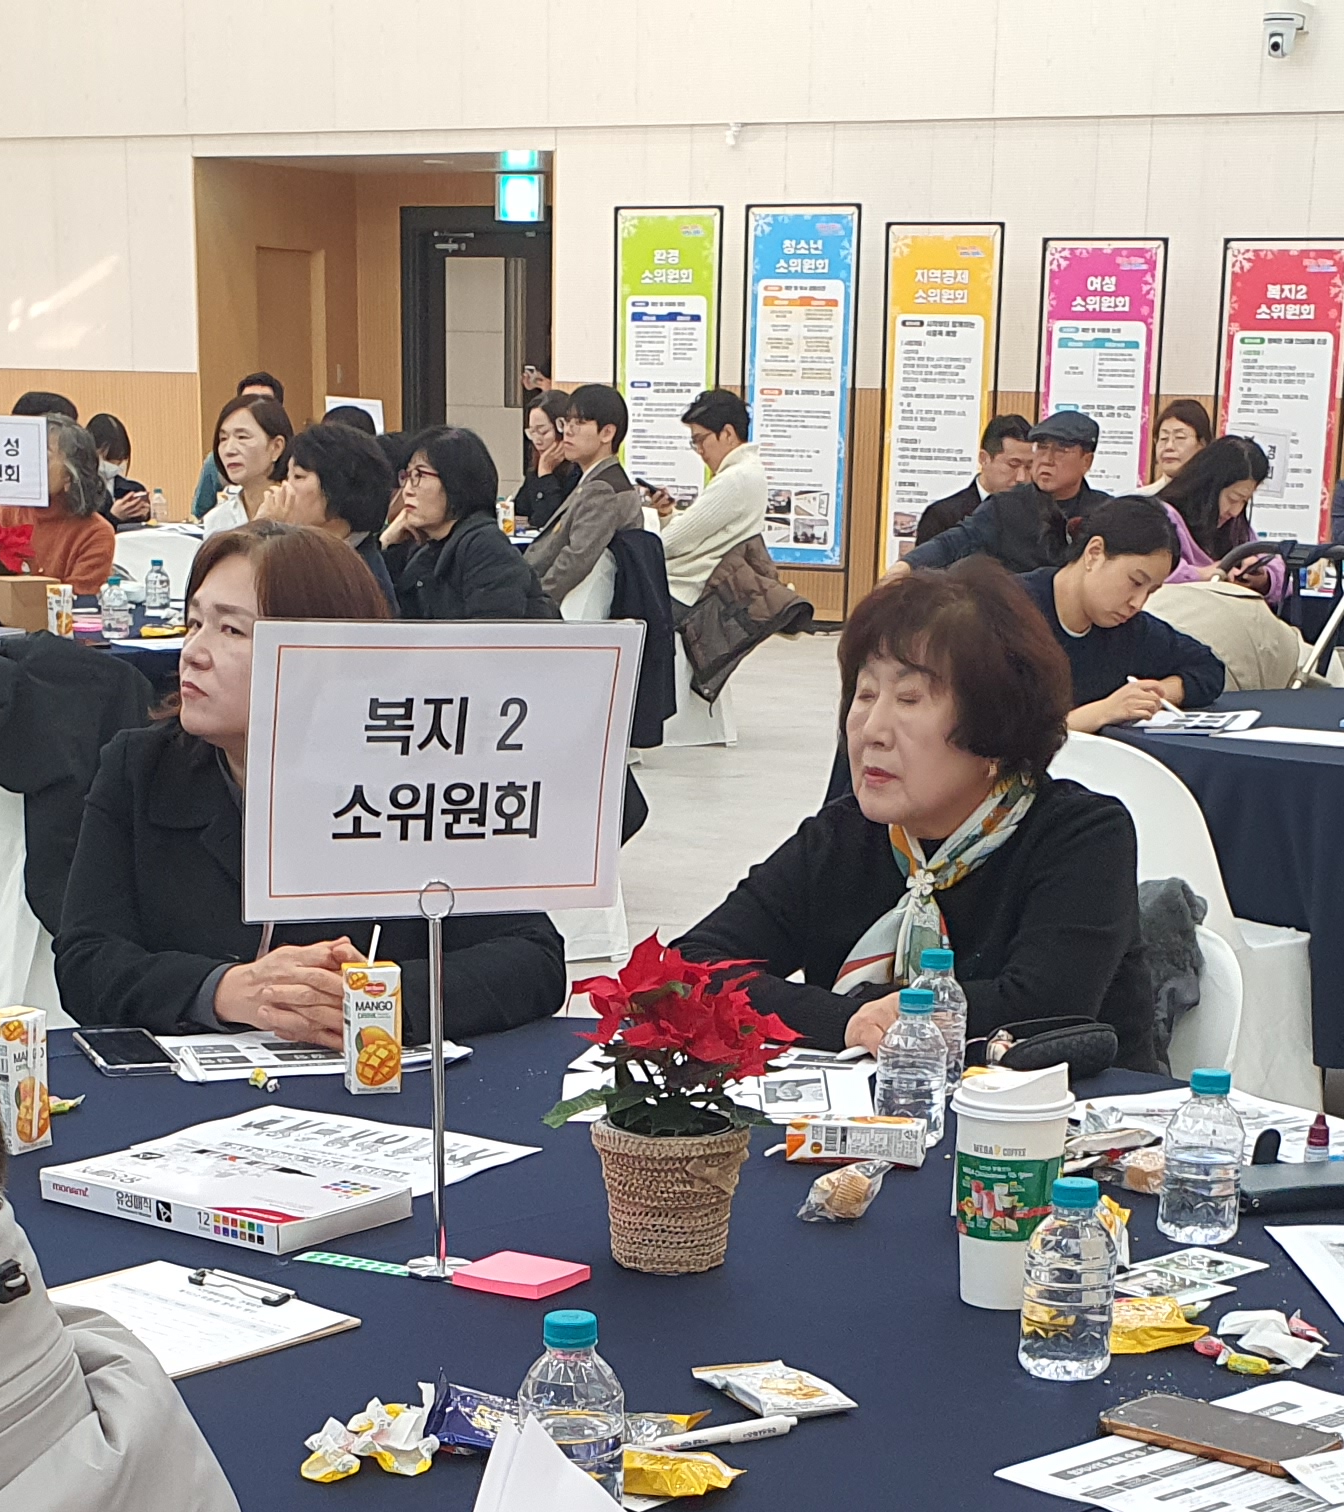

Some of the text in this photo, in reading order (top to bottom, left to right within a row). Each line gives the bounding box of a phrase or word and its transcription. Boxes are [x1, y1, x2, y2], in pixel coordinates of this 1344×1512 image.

[782, 239, 823, 255] 청소년
[653, 248, 680, 265] 환경
[775, 258, 830, 274] 소위원회
[640, 268, 693, 284] 소위원회
[914, 269, 969, 285] 지역경제
[1086, 275, 1117, 292] 여성
[913, 289, 968, 304] 소위원회
[1266, 284, 1308, 300] 복지2
[1071, 296, 1131, 312] 소위원회
[1255, 304, 1316, 320] 소위원회
[364, 696, 529, 756] 복지 2
[332, 781, 543, 841] 소위원회
[355, 1001, 393, 1011] MANGO
[52, 1182, 90, 1198] monami
[115, 1190, 152, 1213] 유성매직
[197, 1211, 210, 1226] 12
